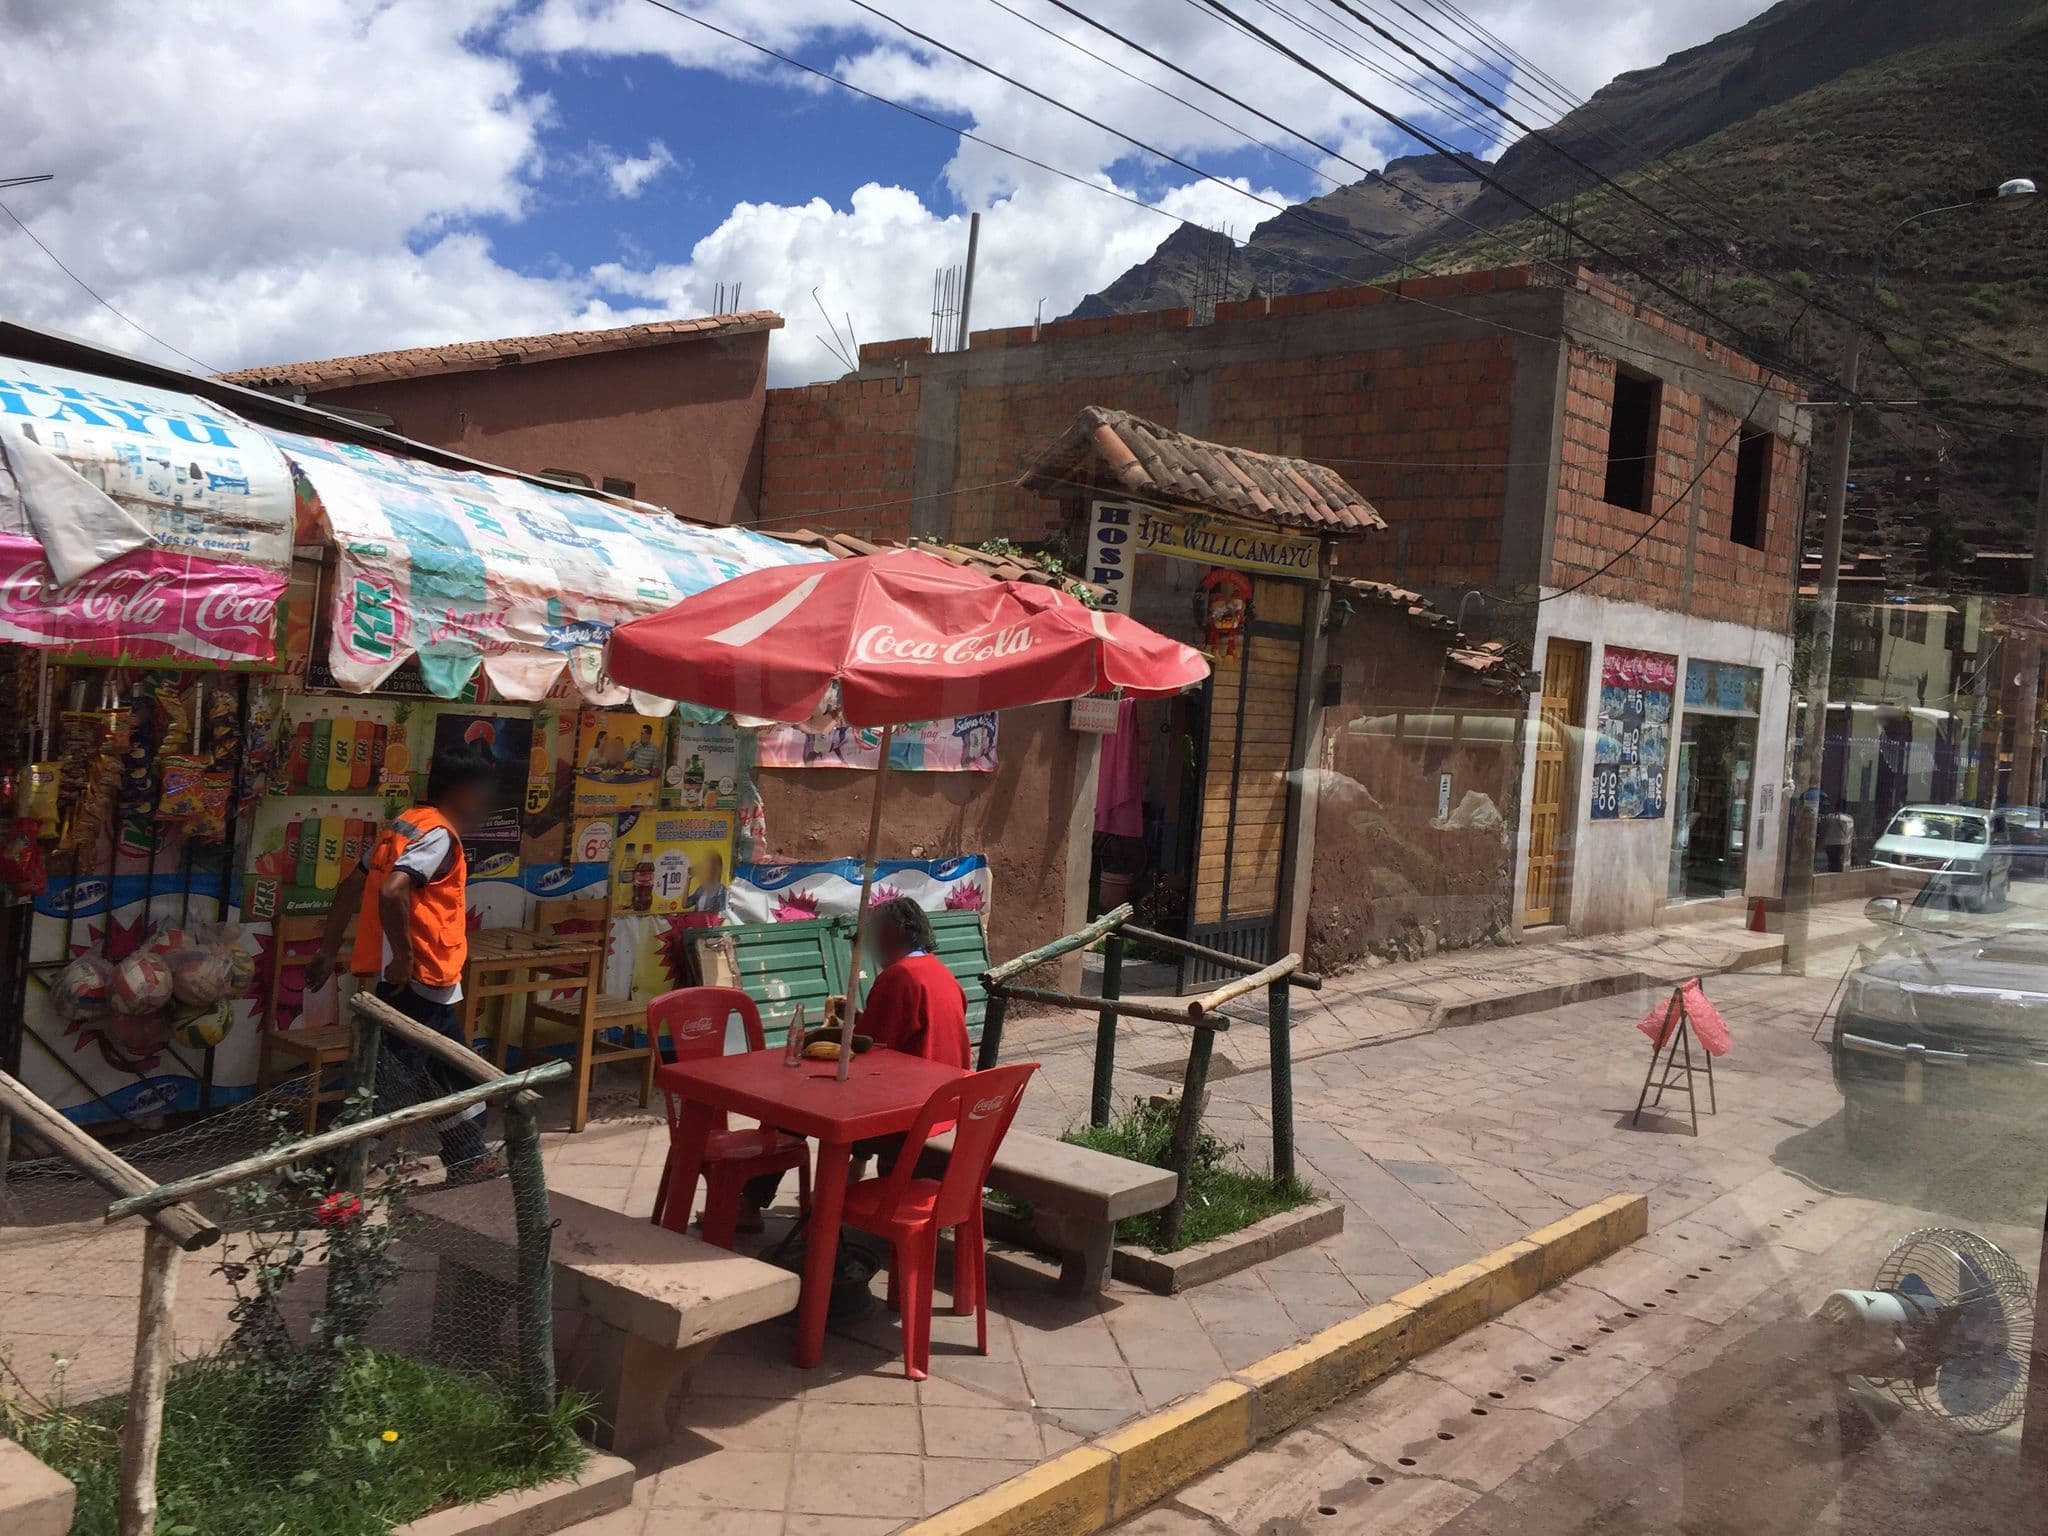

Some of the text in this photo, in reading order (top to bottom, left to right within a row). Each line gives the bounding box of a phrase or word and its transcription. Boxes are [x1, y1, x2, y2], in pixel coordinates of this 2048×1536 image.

[203, 539, 250, 551] general
[1184, 526, 1313, 569] WILLCAMAYÚ
[350, 578, 396, 661] KR
[856, 624, 1034, 664] Coca-Cola
[252, 879, 279, 919] KR
